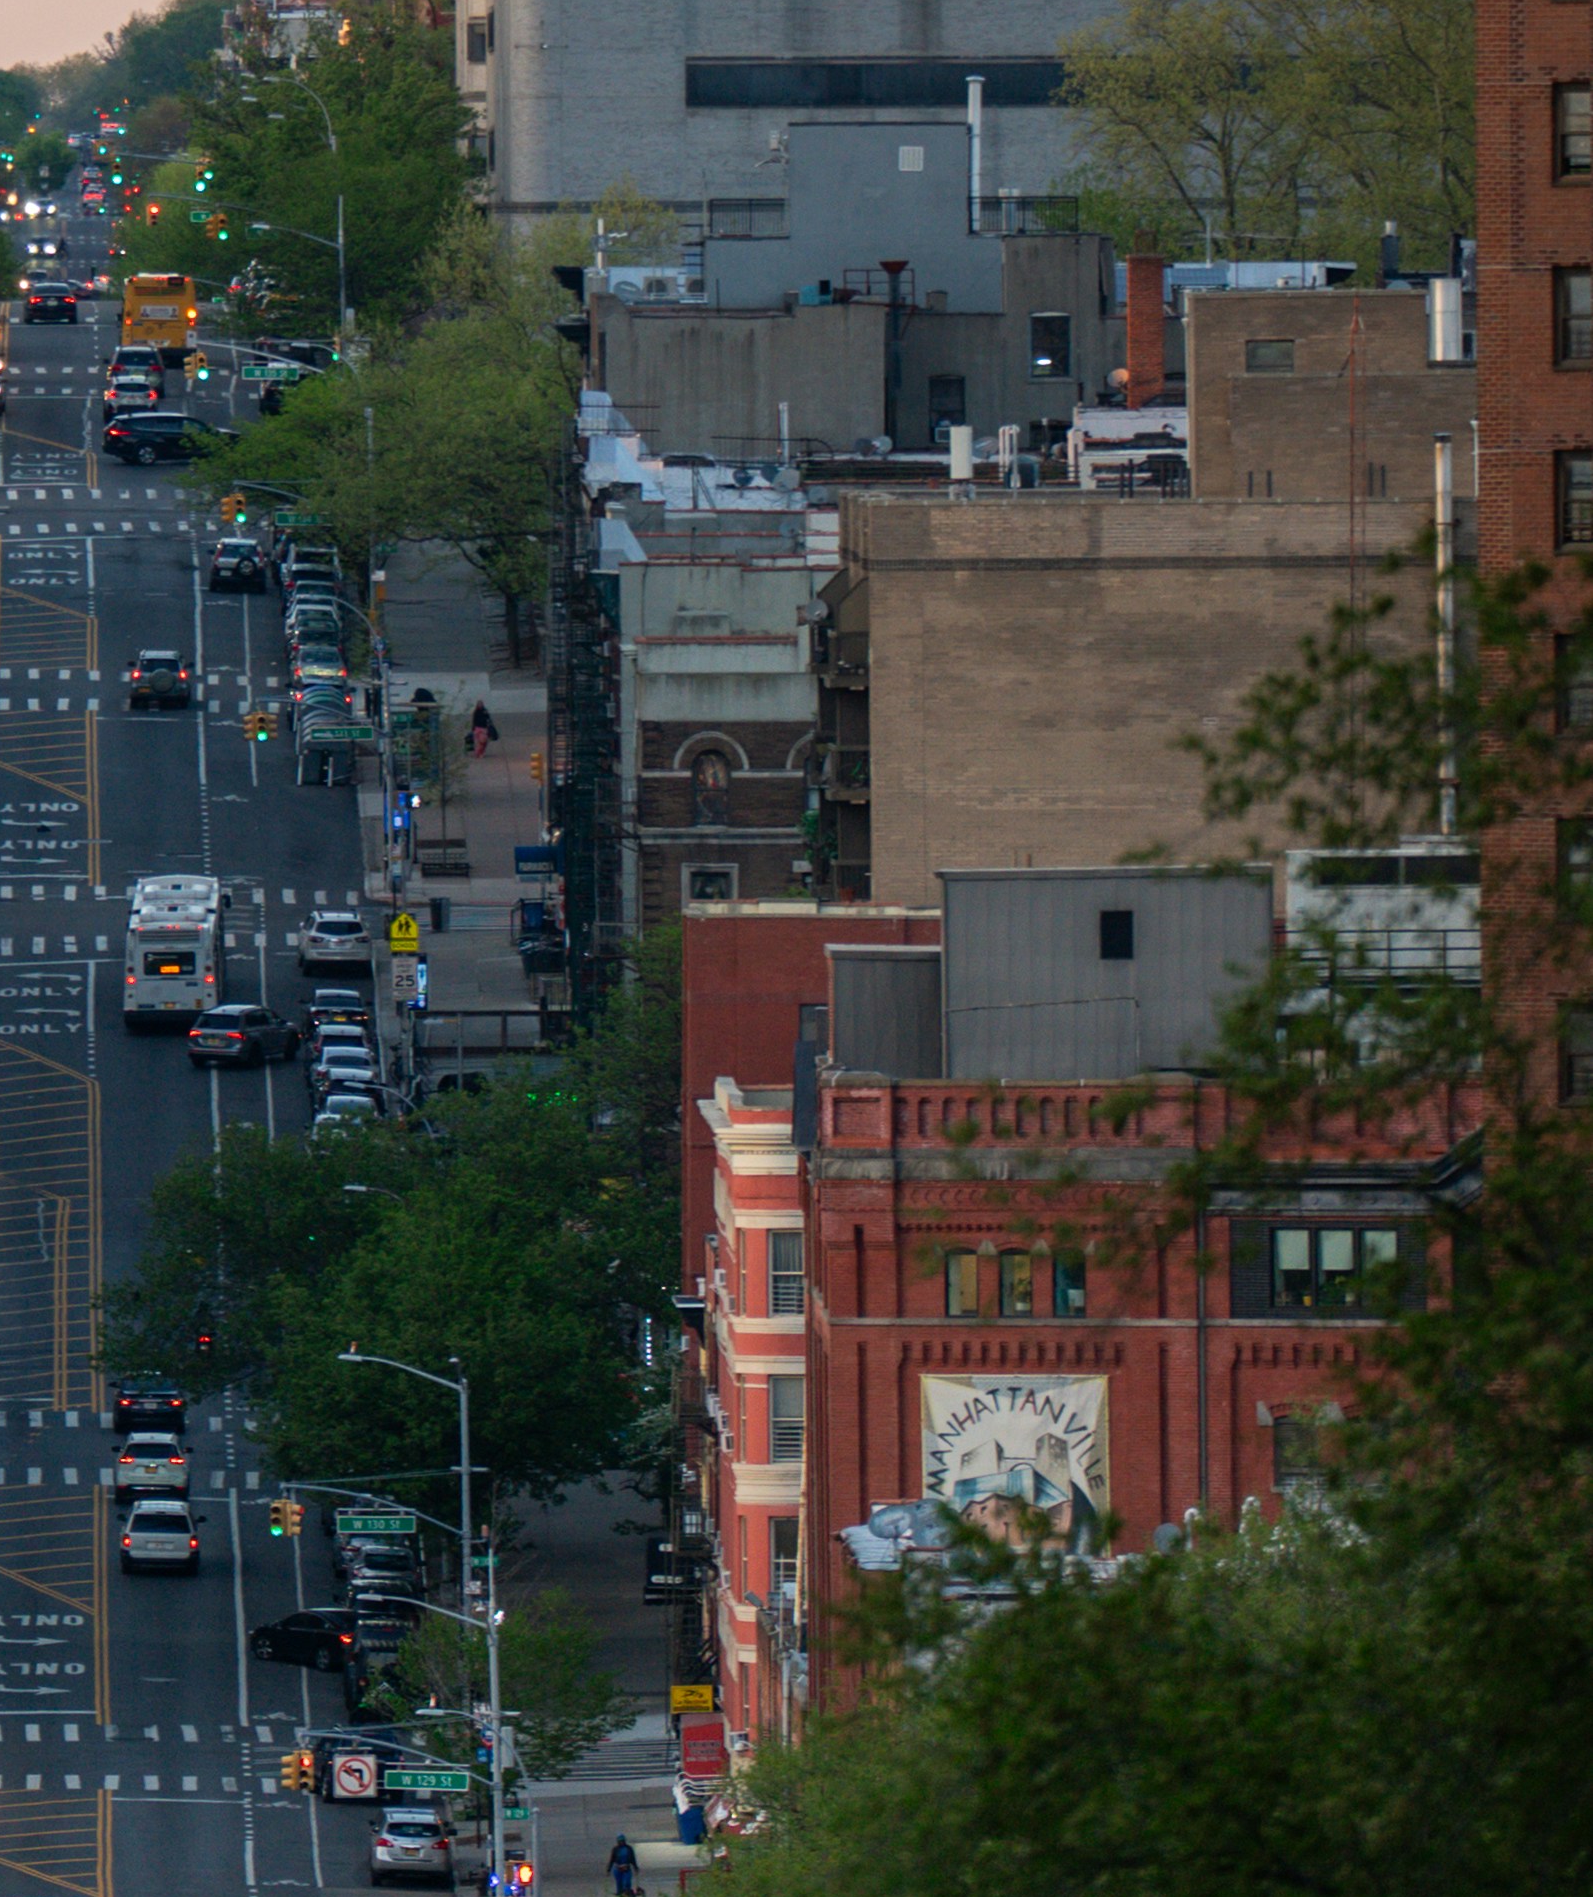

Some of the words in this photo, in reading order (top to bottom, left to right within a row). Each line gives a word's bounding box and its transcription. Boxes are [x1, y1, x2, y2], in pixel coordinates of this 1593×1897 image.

[395, 975, 415, 987] 25
[926, 1386, 1104, 1495] MANHATTANVILLE
[352, 1519, 363, 1529] W
[366, 1518, 381, 1530] 130
[401, 1775, 412, 1785] W
[417, 1776, 436, 1786] 129
[440, 1776, 452, 1787] St
